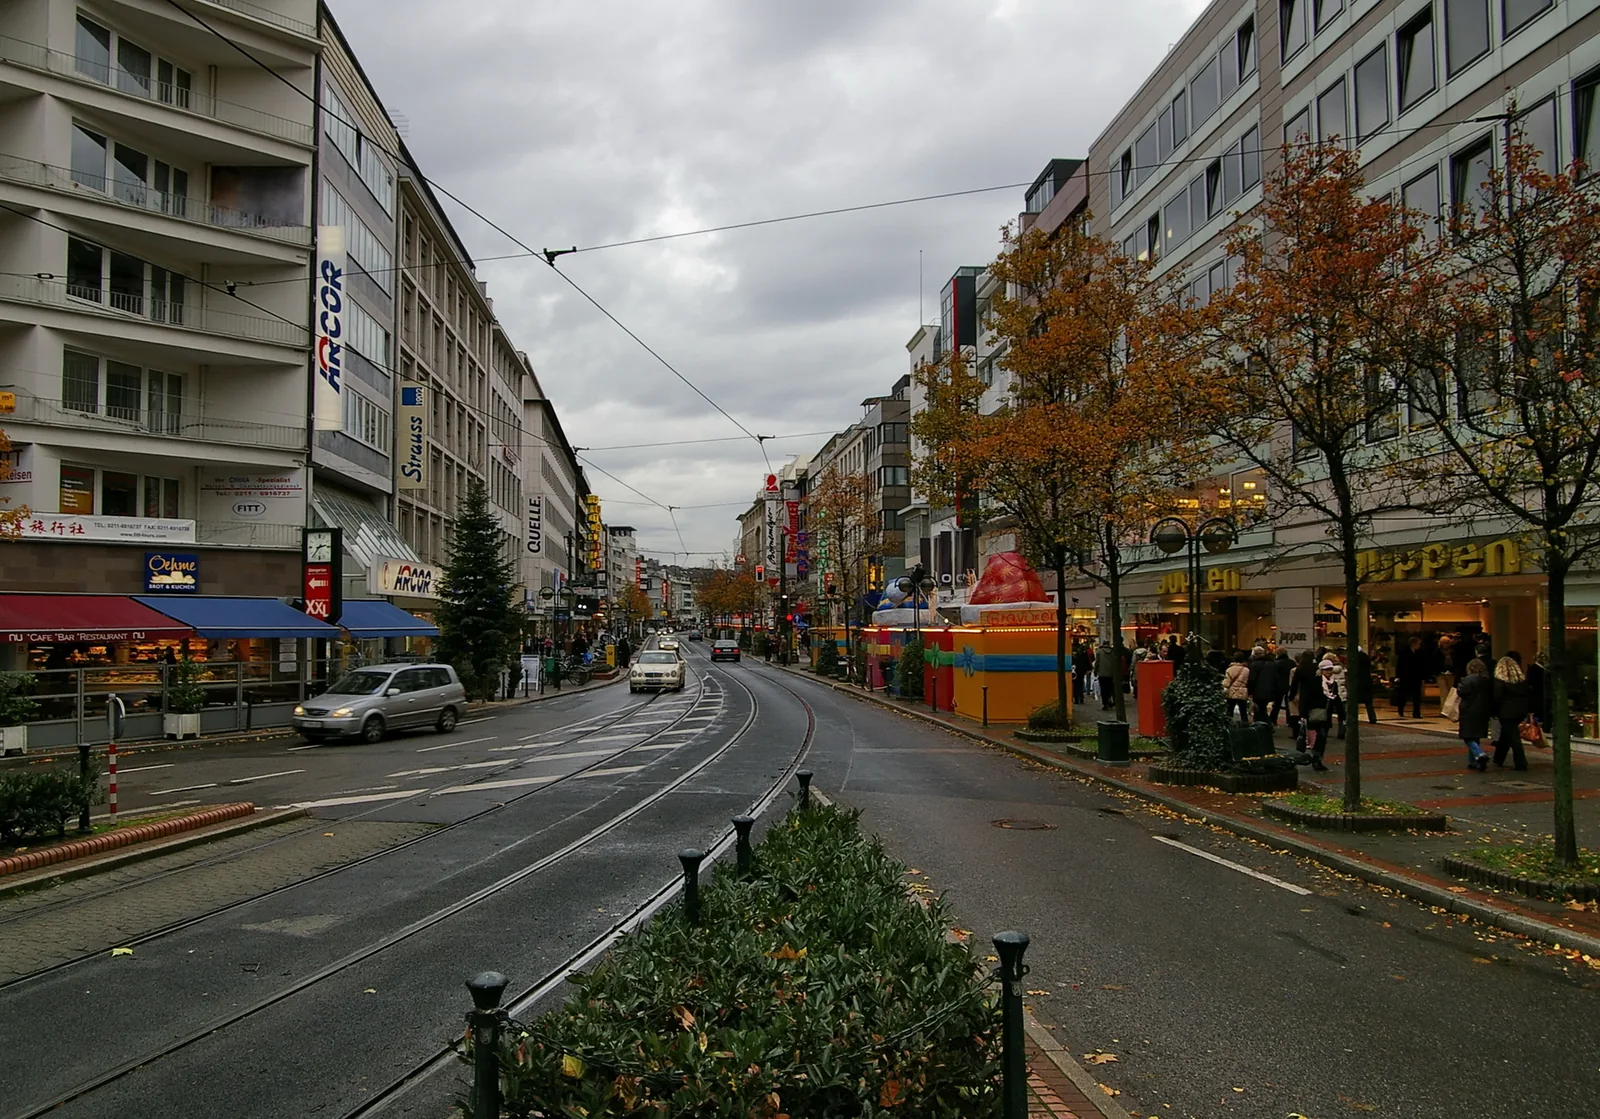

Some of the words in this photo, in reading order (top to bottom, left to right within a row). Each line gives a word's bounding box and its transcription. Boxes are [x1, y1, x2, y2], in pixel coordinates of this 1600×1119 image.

[319, 260, 342, 394] ARCOR
[401, 416, 422, 482] Strauss
[237, 504, 260, 512] FITT
[149, 554, 196, 571] Oehme
[394, 565, 432, 593] ARCOR
[306, 600, 329, 617] XXL
